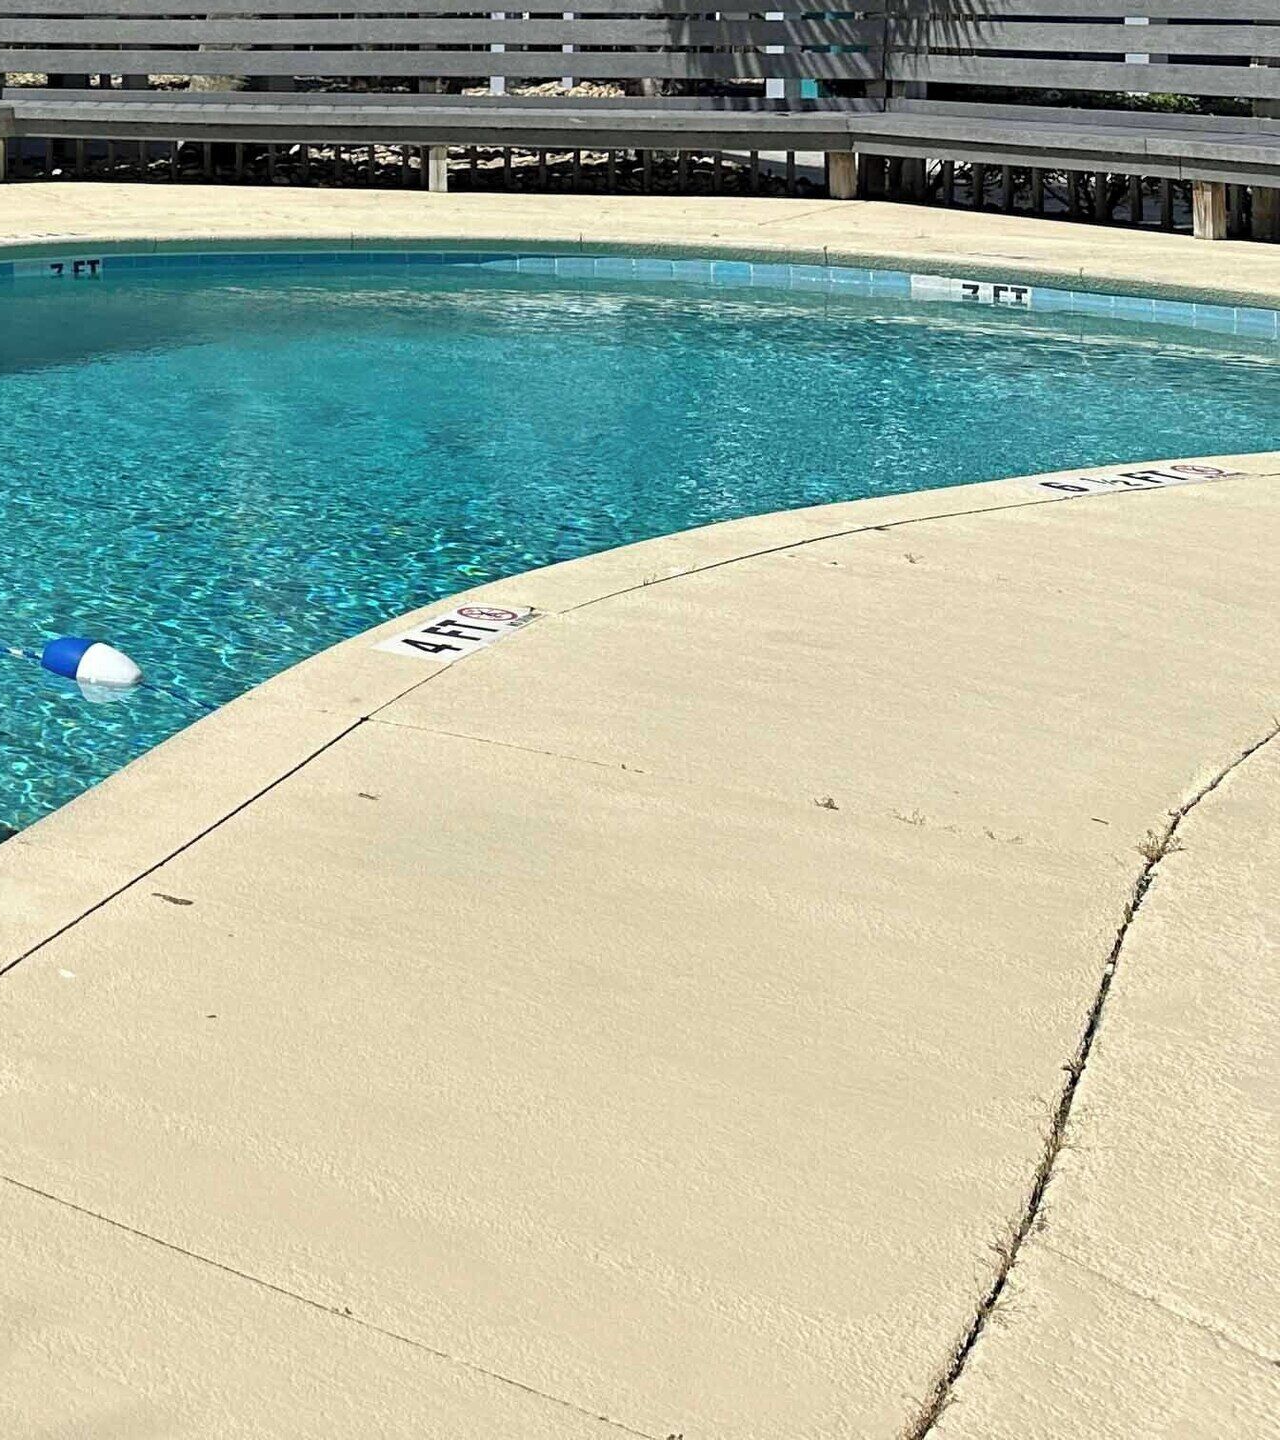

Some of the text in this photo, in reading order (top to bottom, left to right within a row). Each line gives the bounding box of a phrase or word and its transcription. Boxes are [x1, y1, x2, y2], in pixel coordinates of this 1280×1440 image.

[1039, 482, 1089, 492] 6
[1118, 470, 1189, 483] FT
[421, 619, 500, 641] FT
[401, 639, 463, 653] 4
